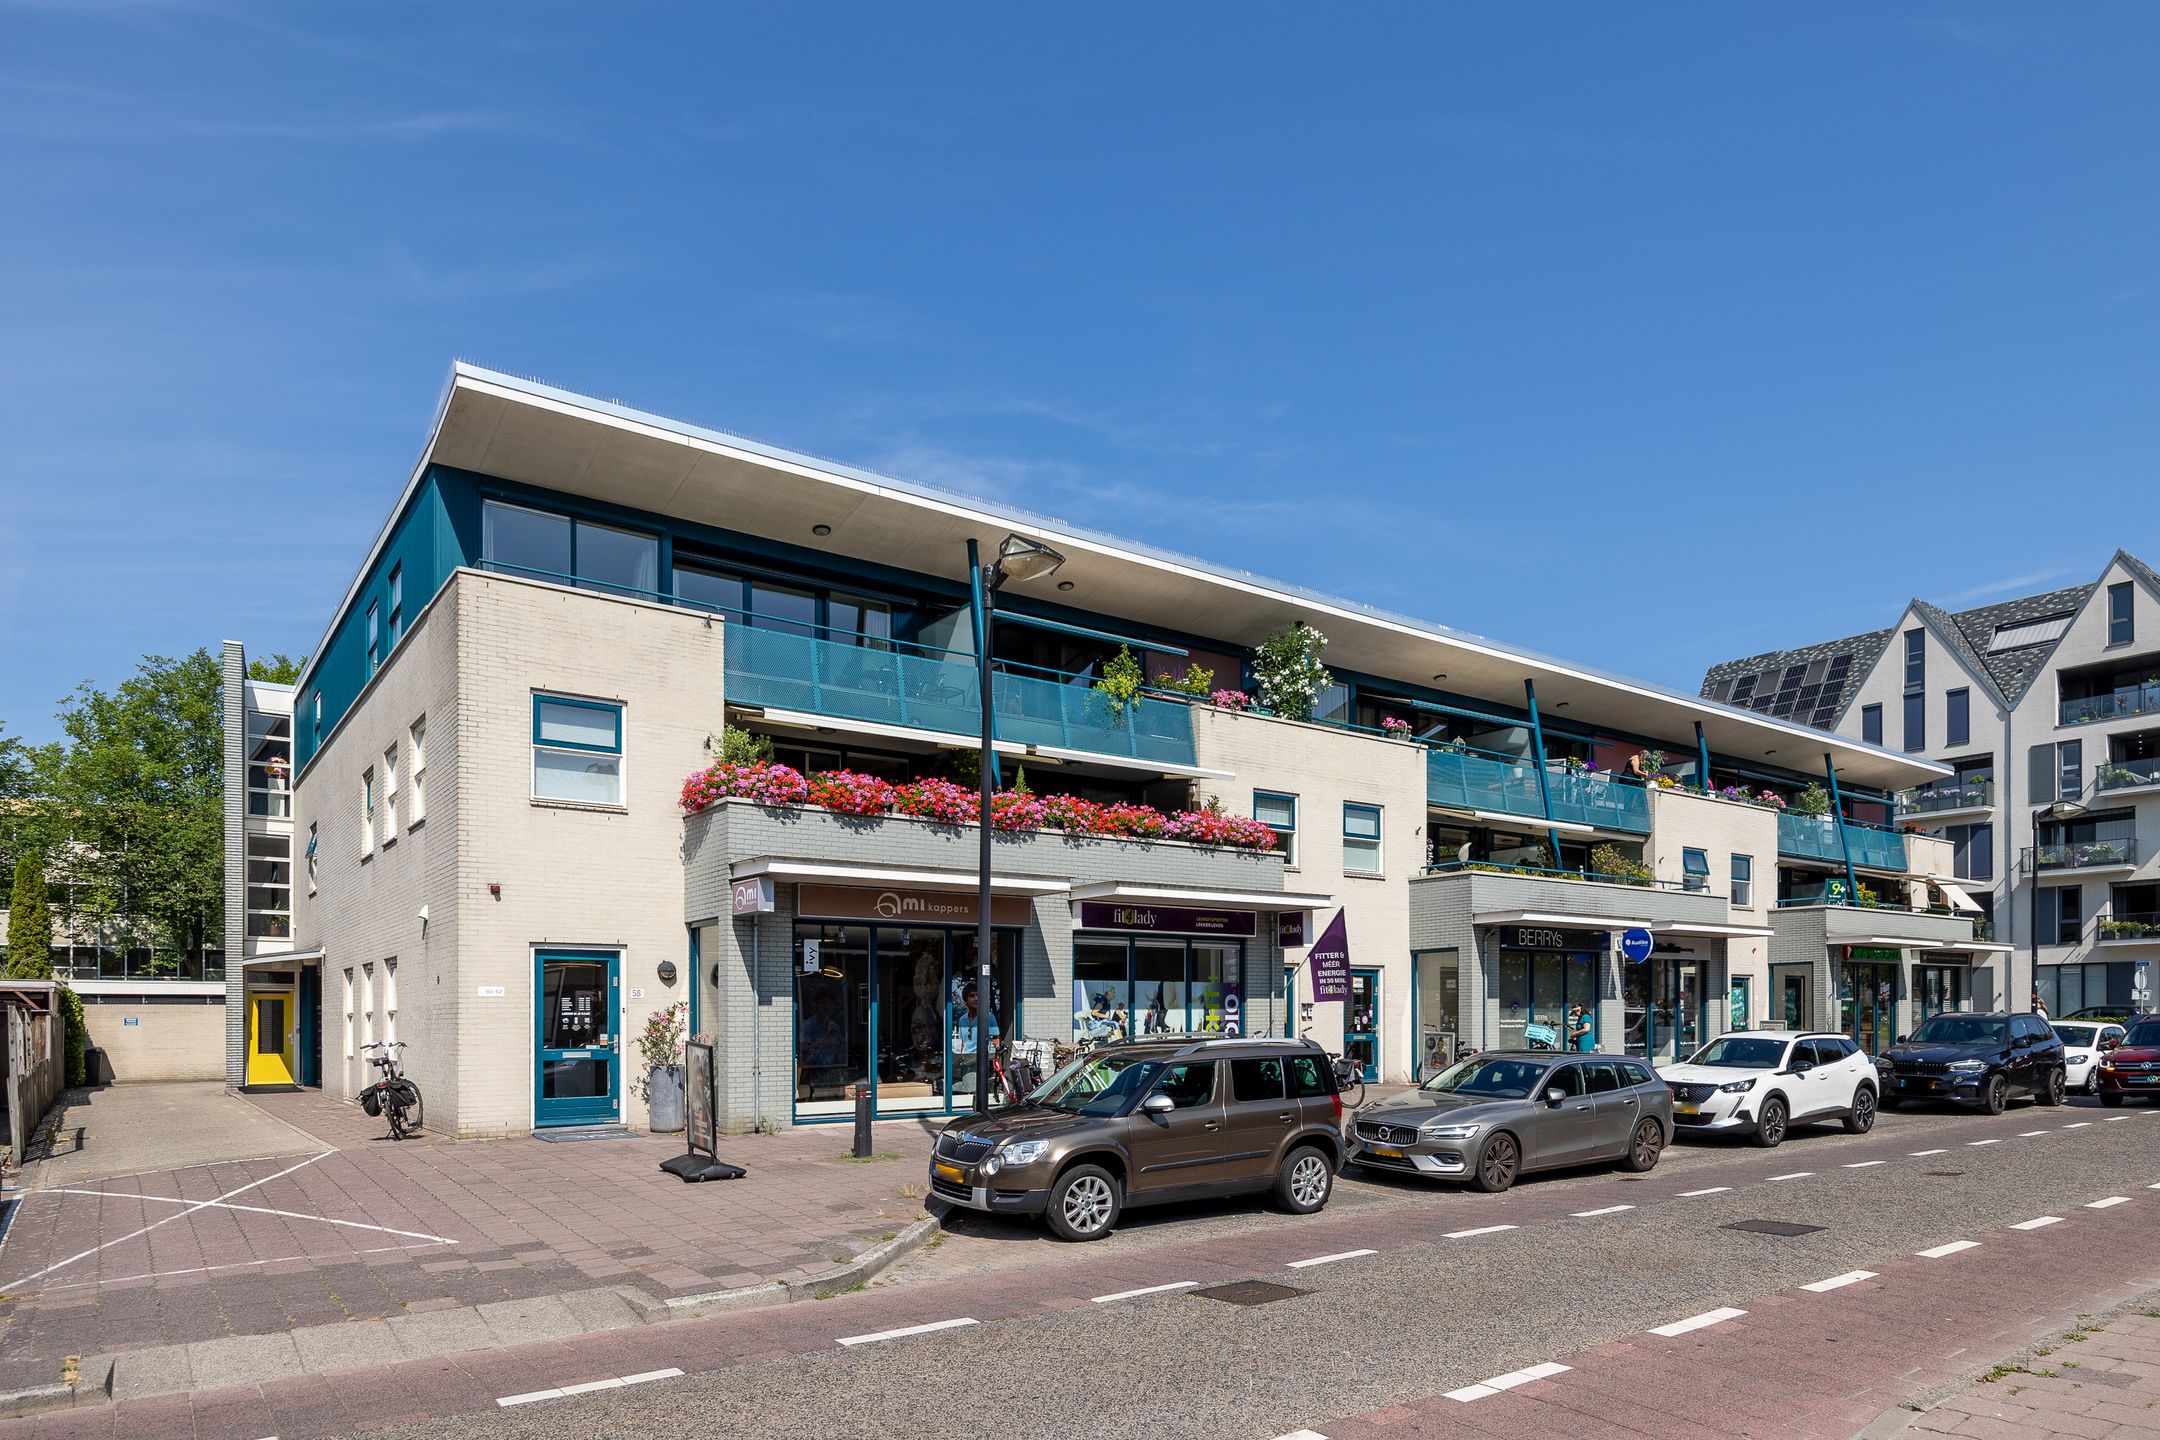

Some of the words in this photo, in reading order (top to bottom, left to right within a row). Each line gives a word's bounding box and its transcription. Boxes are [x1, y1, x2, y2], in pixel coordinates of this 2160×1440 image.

[928, 903, 969, 914] kappers
[1113, 908, 1157, 927] fit4lady
[806, 947, 817, 964] ivy
[632, 990, 642, 998] 58
[1320, 984, 1348, 995] fit4lady
